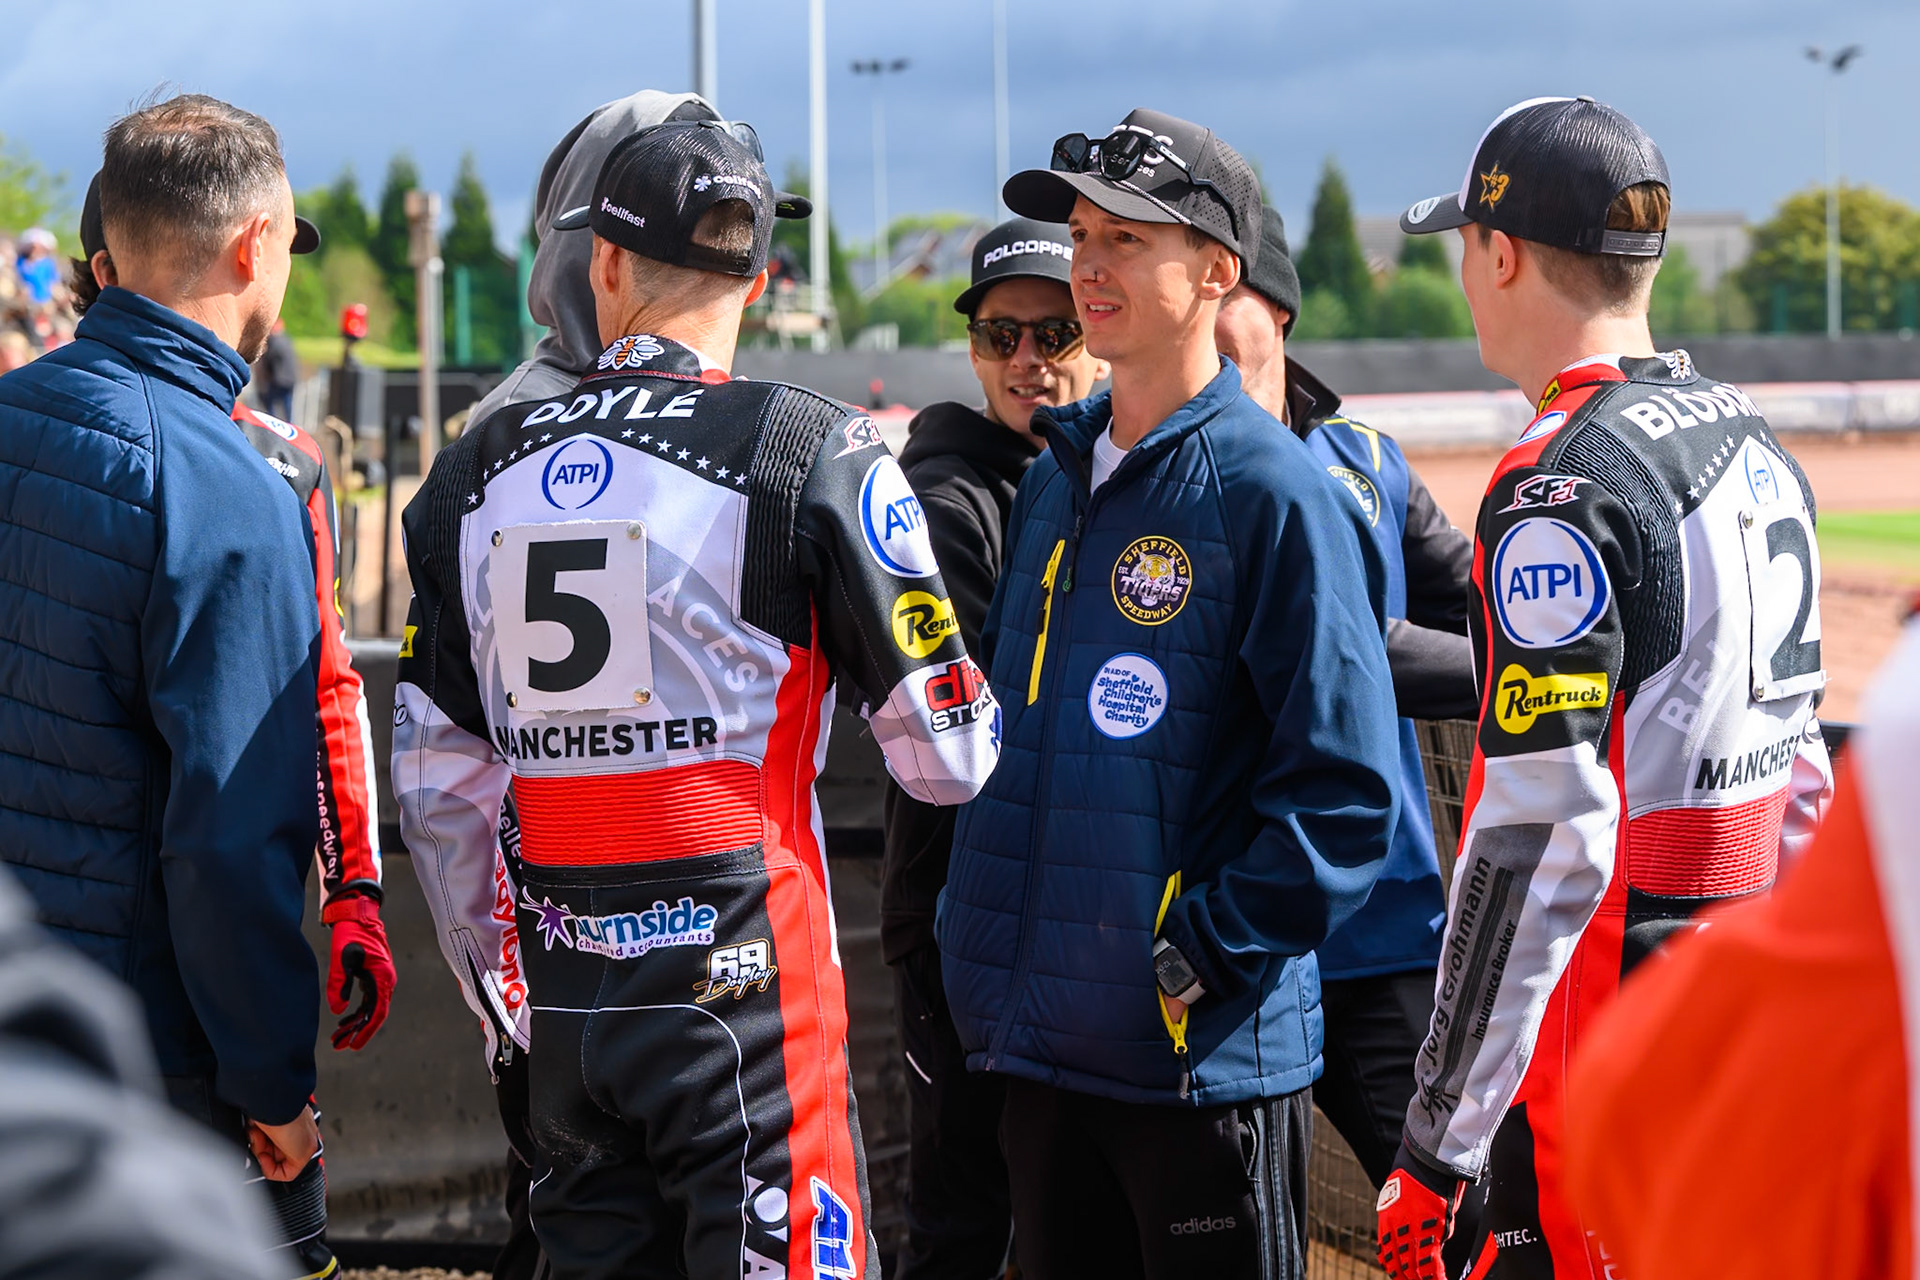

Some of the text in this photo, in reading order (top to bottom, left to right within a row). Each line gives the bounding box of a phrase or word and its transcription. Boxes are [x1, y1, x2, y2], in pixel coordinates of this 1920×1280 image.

[606, 203, 646, 228] cellfast
[983, 239, 1074, 268] POLCOPPE
[520, 385, 705, 429] DOYLE
[551, 463, 600, 487] ATPI
[1124, 540, 1187, 576] SHEFFIELD
[1120, 575, 1184, 602] TIGERS
[1507, 562, 1582, 604] ATPI
[1765, 516, 1821, 682] 2
[523, 537, 612, 693] 5
[1120, 595, 1172, 619] SPEEDWAY
[646, 575, 760, 692] ACES
[1097, 676, 1154, 696] Sheffield
[1103, 687, 1162, 708] Children's
[1502, 679, 1603, 722] Rentruck
[1098, 694, 1147, 715] Hospital
[1104, 709, 1150, 729] Charity
[496, 715, 718, 761] MANCHESTER
[629, 932, 713, 955] accountants
[1441, 855, 1492, 1003] Grohmann
[708, 940, 769, 982] 69
[1471, 918, 1519, 1043] Insurance Broker
[1169, 1215, 1238, 1237] adidas
